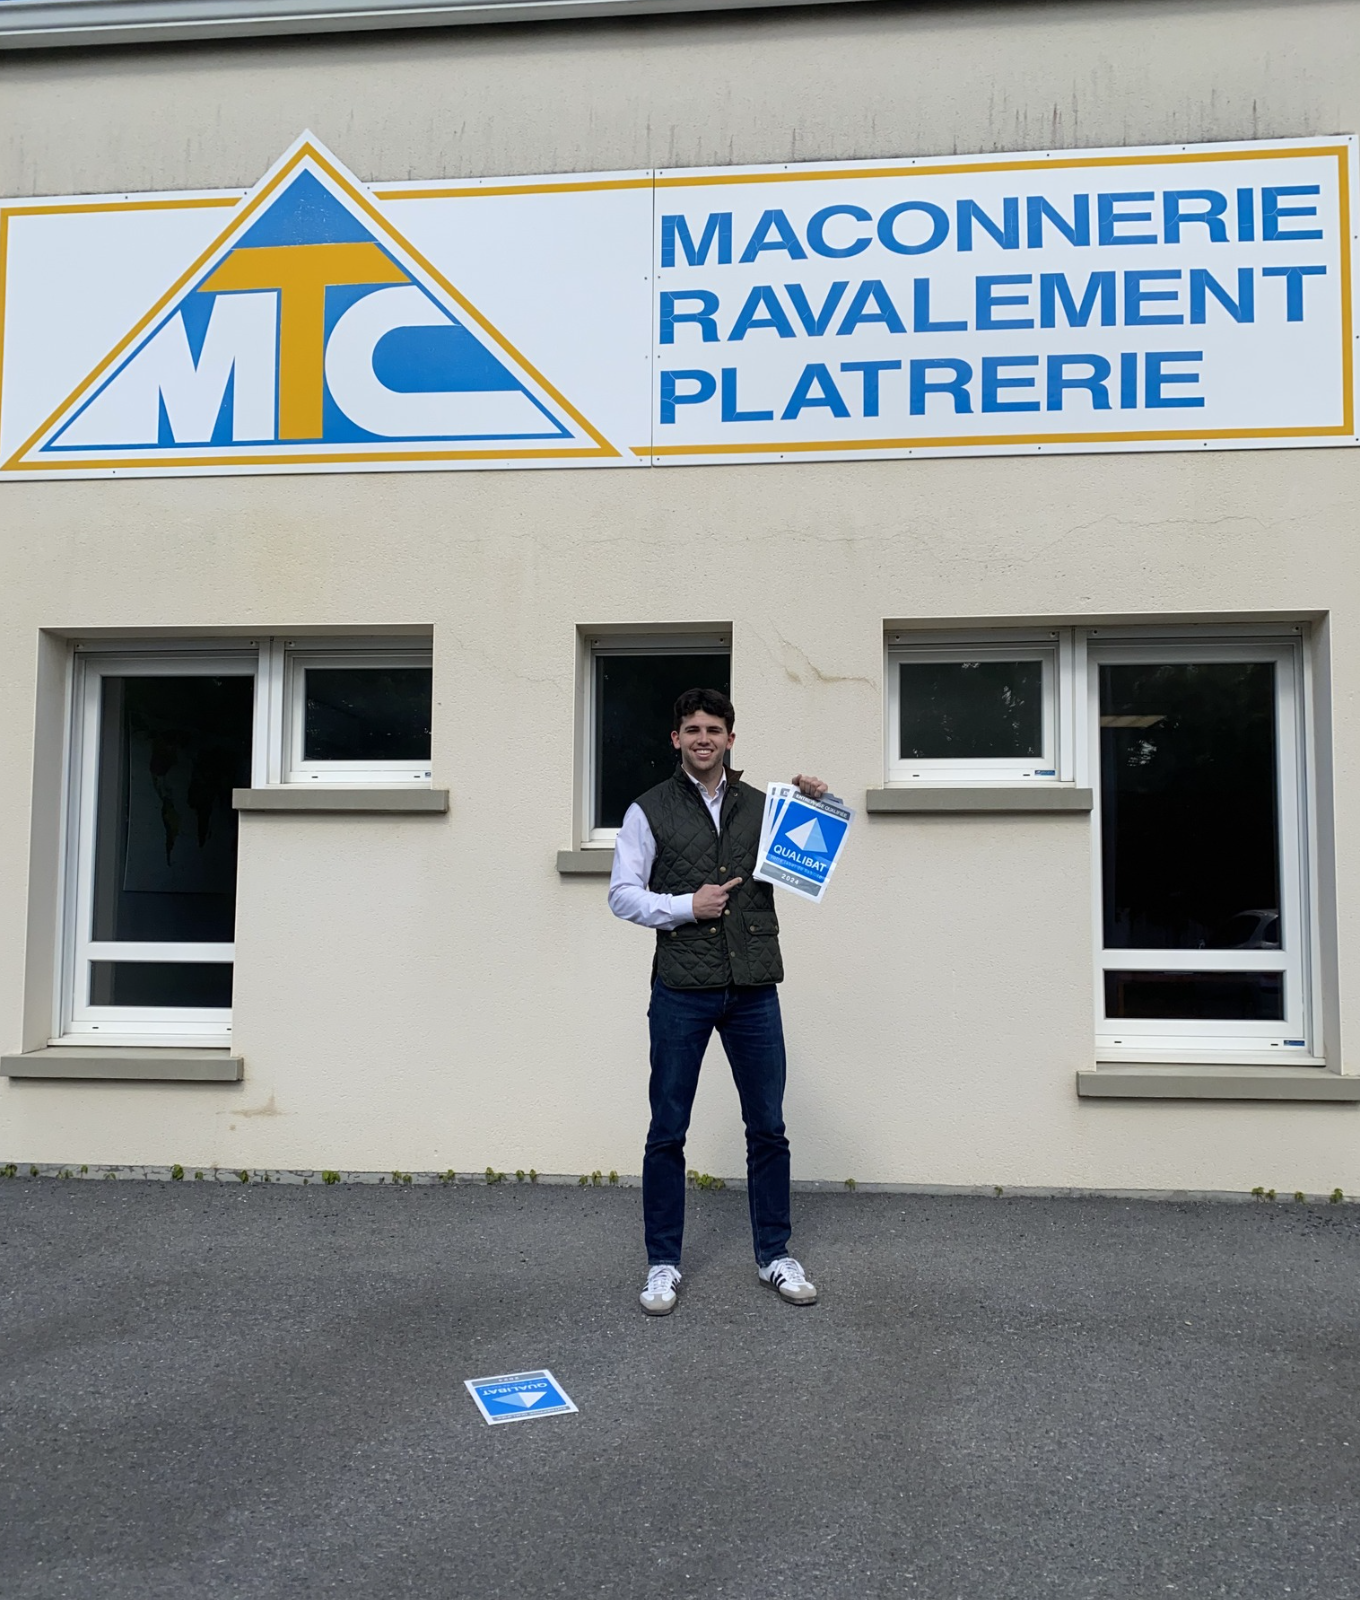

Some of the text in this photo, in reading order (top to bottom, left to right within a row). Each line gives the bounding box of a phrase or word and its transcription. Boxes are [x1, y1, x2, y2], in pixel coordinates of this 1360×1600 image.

[660, 184, 1324, 268] MACONNERIE
[658, 265, 1327, 345] RAVALEMENT
[50, 241, 560, 446] MTC
[658, 350, 1205, 425] PLATRERIE
[773, 844, 827, 872] QUALIBAT
[781, 873, 799, 885] 2024
[482, 1382, 548, 1396] QUALIBAT
